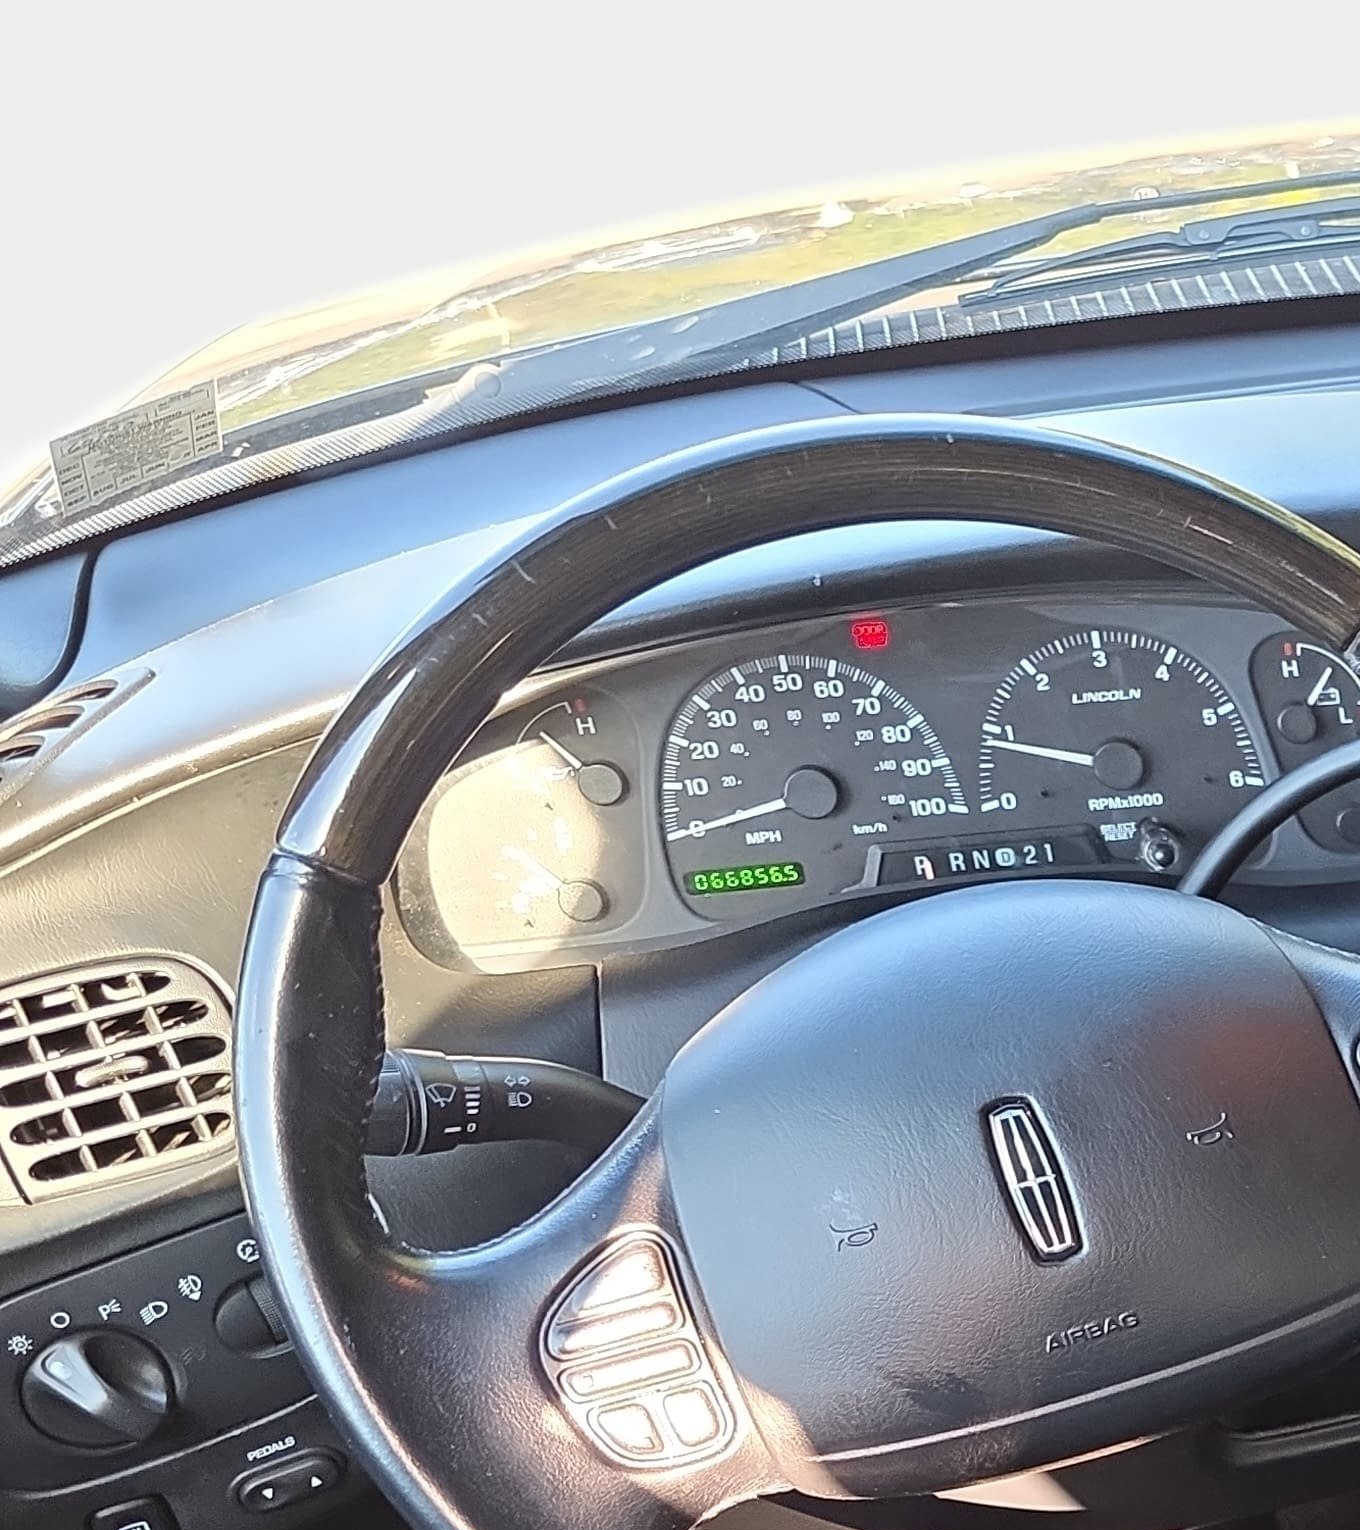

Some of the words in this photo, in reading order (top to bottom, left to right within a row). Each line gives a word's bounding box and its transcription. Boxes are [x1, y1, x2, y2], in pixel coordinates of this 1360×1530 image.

[1092, 650, 1107, 668] 3
[1155, 664, 1170, 681] 4
[1282, 660, 1299, 678] H
[772, 673, 802, 692] 50
[813, 679, 844, 698] 60
[1034, 673, 1051, 692] 2
[735, 685, 765, 702] 40
[1071, 688, 1141, 705] LINCOLN
[851, 697, 881, 716] 70
[1339, 707, 1353, 724] L
[575, 716, 597, 735] H
[706, 709, 737, 728] 30
[821, 712, 840, 723] 100
[1202, 709, 1217, 726] 5
[881, 724, 911, 743] 80
[1004, 725, 1015, 741] 1
[689, 741, 720, 760] 20
[730, 743, 745, 754] 40
[879, 760, 897, 771] 140
[902, 759, 931, 777] 90
[684, 778, 709, 796] 10
[721, 775, 736, 787] 20
[1229, 770, 1244, 787] 6
[909, 798, 946, 816] 100
[1000, 793, 1017, 809] 0
[1088, 793, 1164, 811] RPMx1000
[853, 822, 888, 834] km/h
[745, 830, 782, 845] MPH
[949, 852, 966, 872] R
[972, 849, 990, 870] N
[1023, 845, 1038, 865] 2
[1043, 843, 1055, 862] 1
[1046, 1311, 1140, 1353] AIRBAG
[247, 1436, 296, 1462] PEDALS
